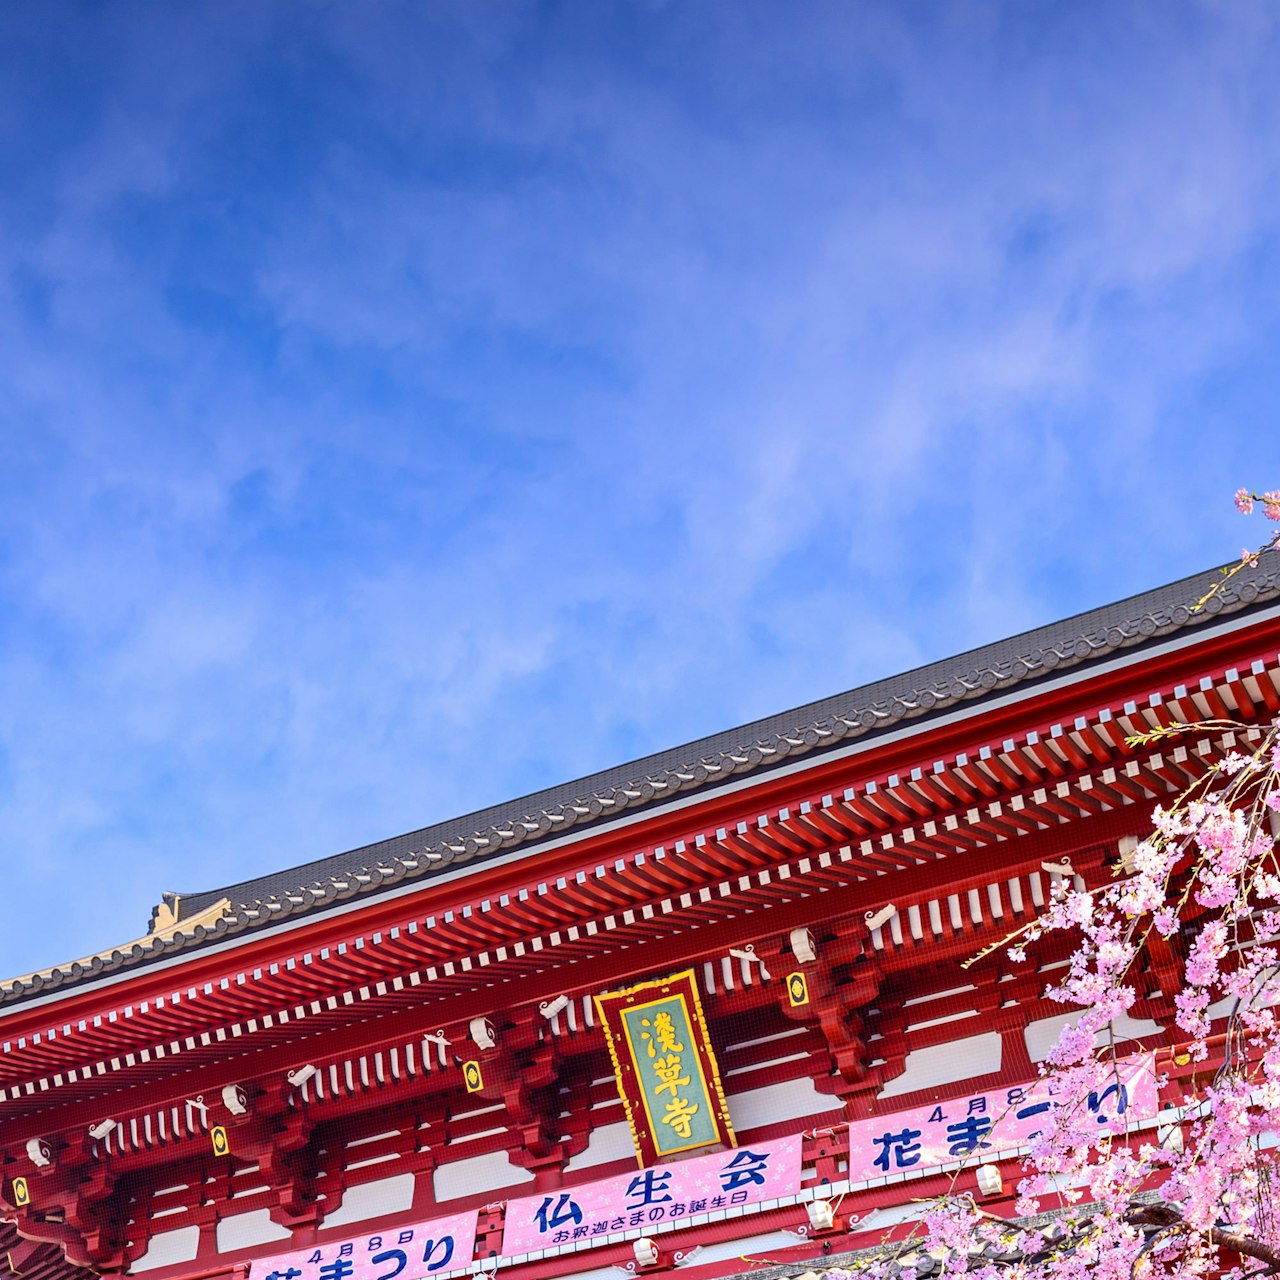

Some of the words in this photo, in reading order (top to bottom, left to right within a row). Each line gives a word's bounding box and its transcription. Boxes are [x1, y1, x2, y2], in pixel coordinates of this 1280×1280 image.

[533, 1150, 771, 1233] 仏生会
[552, 1190, 748, 1243] お釈迦さまのお誕生日
[307, 1230, 414, 1264] 4月8日
